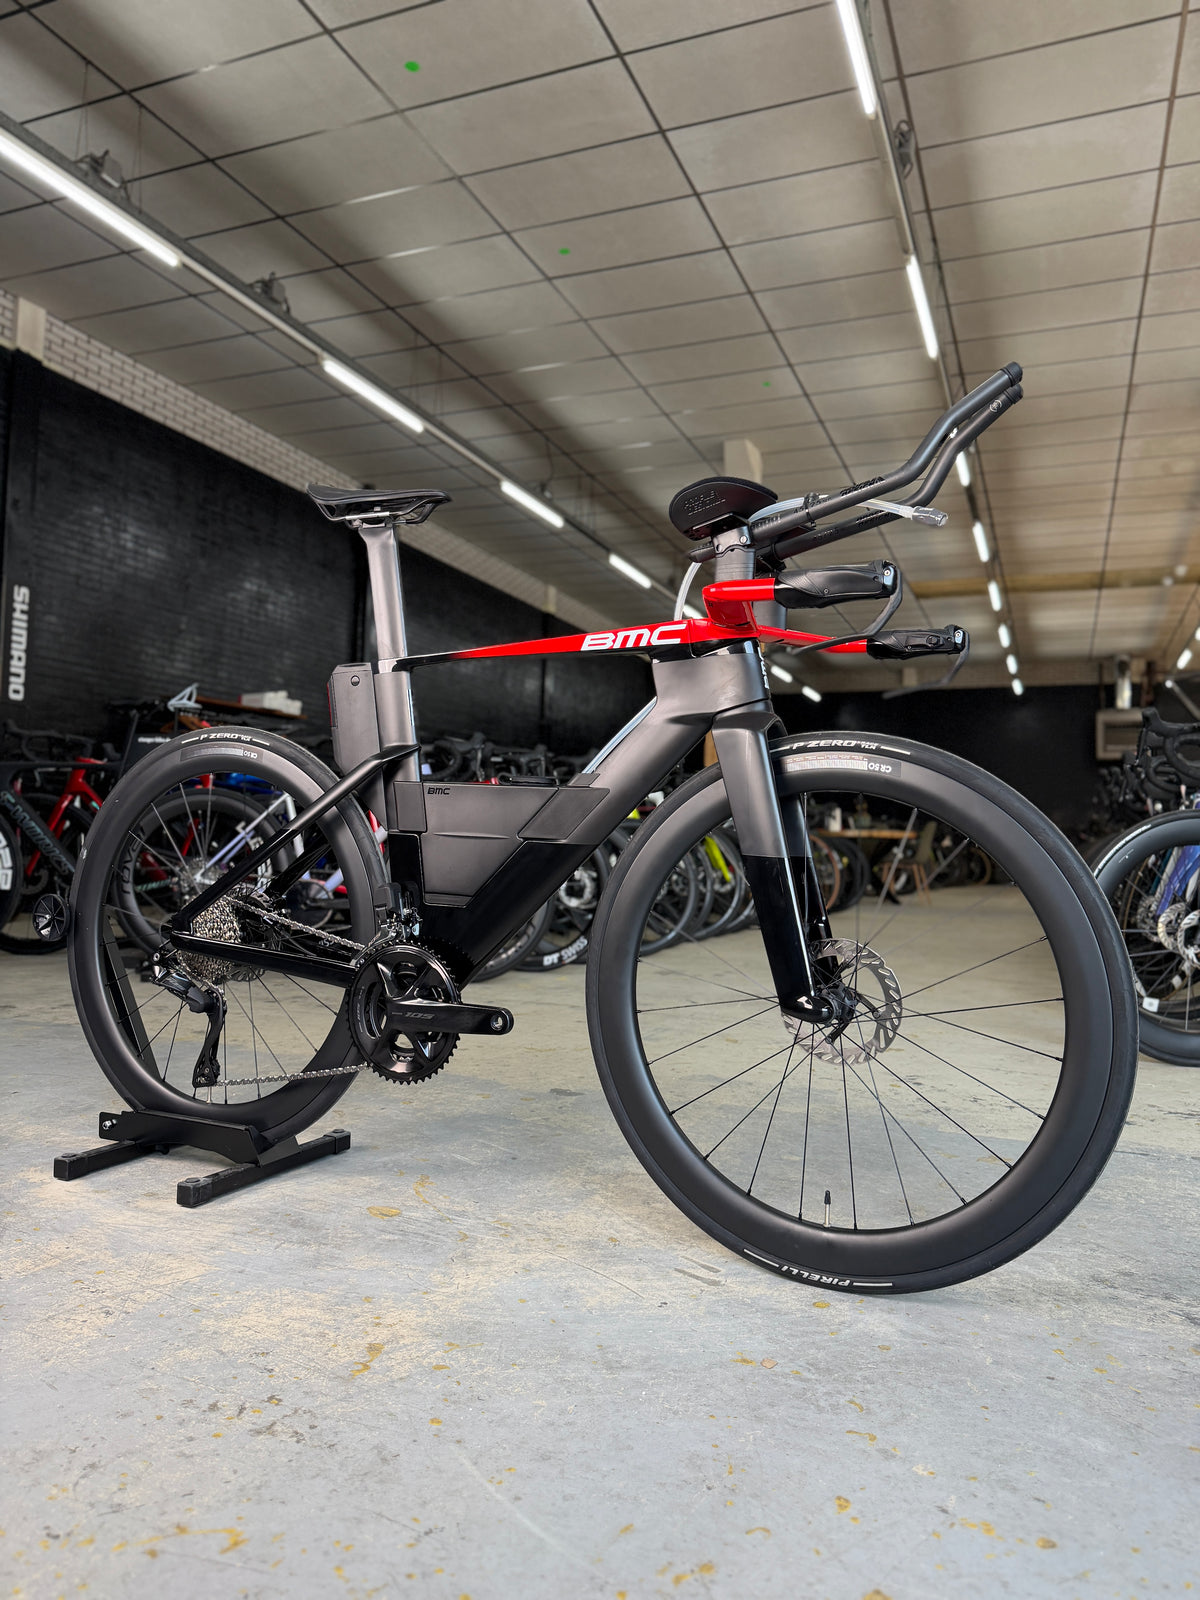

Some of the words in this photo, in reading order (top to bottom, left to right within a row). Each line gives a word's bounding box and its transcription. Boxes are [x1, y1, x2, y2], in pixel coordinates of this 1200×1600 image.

[8, 584, 30, 701] SHIMANO
[580, 624, 687, 651] BMC
[792, 742, 804, 750] P
[806, 739, 855, 748] ZERO
[427, 787, 451, 795] BMC
[543, 950, 559, 966] DT
[561, 937, 589, 962] SWISS
[404, 1011, 436, 1020] 105
[781, 1265, 851, 1287] PIRELLI
